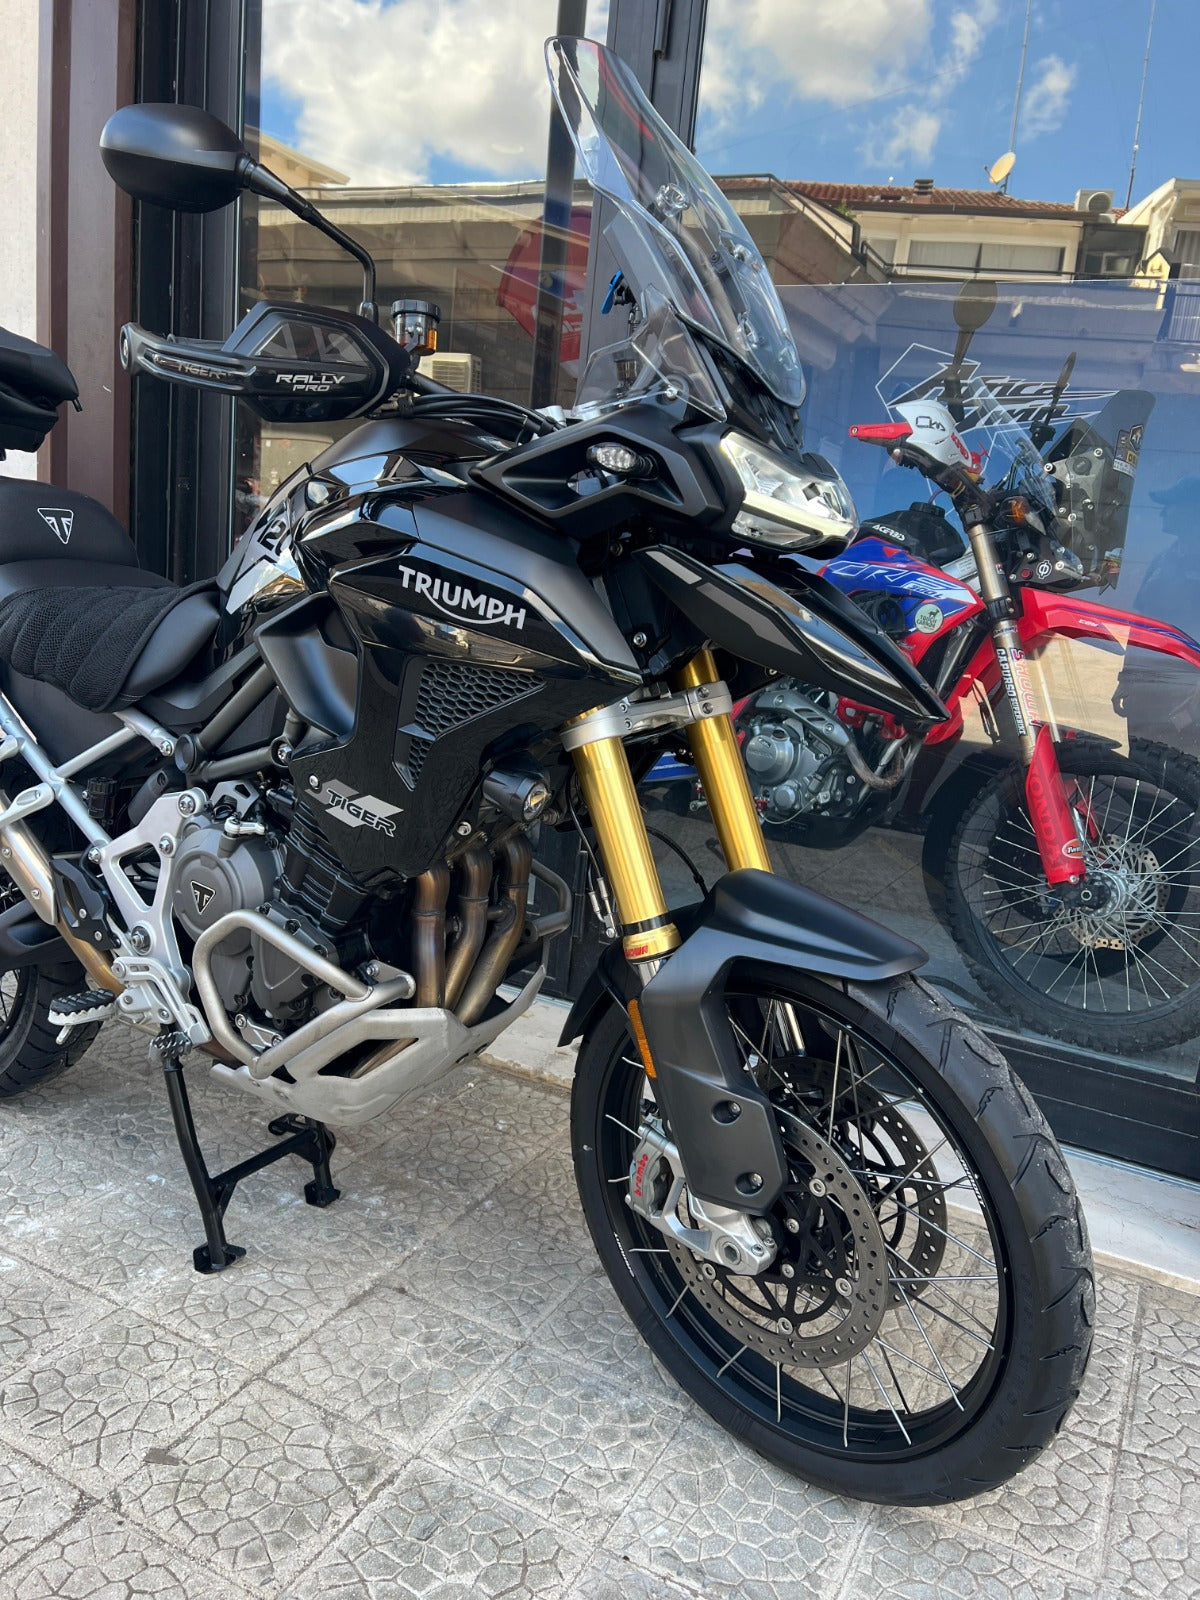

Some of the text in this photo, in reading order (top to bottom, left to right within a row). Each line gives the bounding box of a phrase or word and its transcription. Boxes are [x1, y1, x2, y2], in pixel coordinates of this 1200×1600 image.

[177, 361, 226, 379] TIGER
[275, 374, 346, 384] RALLY
[292, 384, 330, 392] PRO
[398, 564, 527, 630] TRIUMPH
[827, 560, 967, 590] CRF
[996, 647, 1017, 698] CAPURSO
[1010, 648, 1043, 728] SHOWA
[326, 787, 397, 838] TIGER
[633, 1153, 649, 1197] brembo
